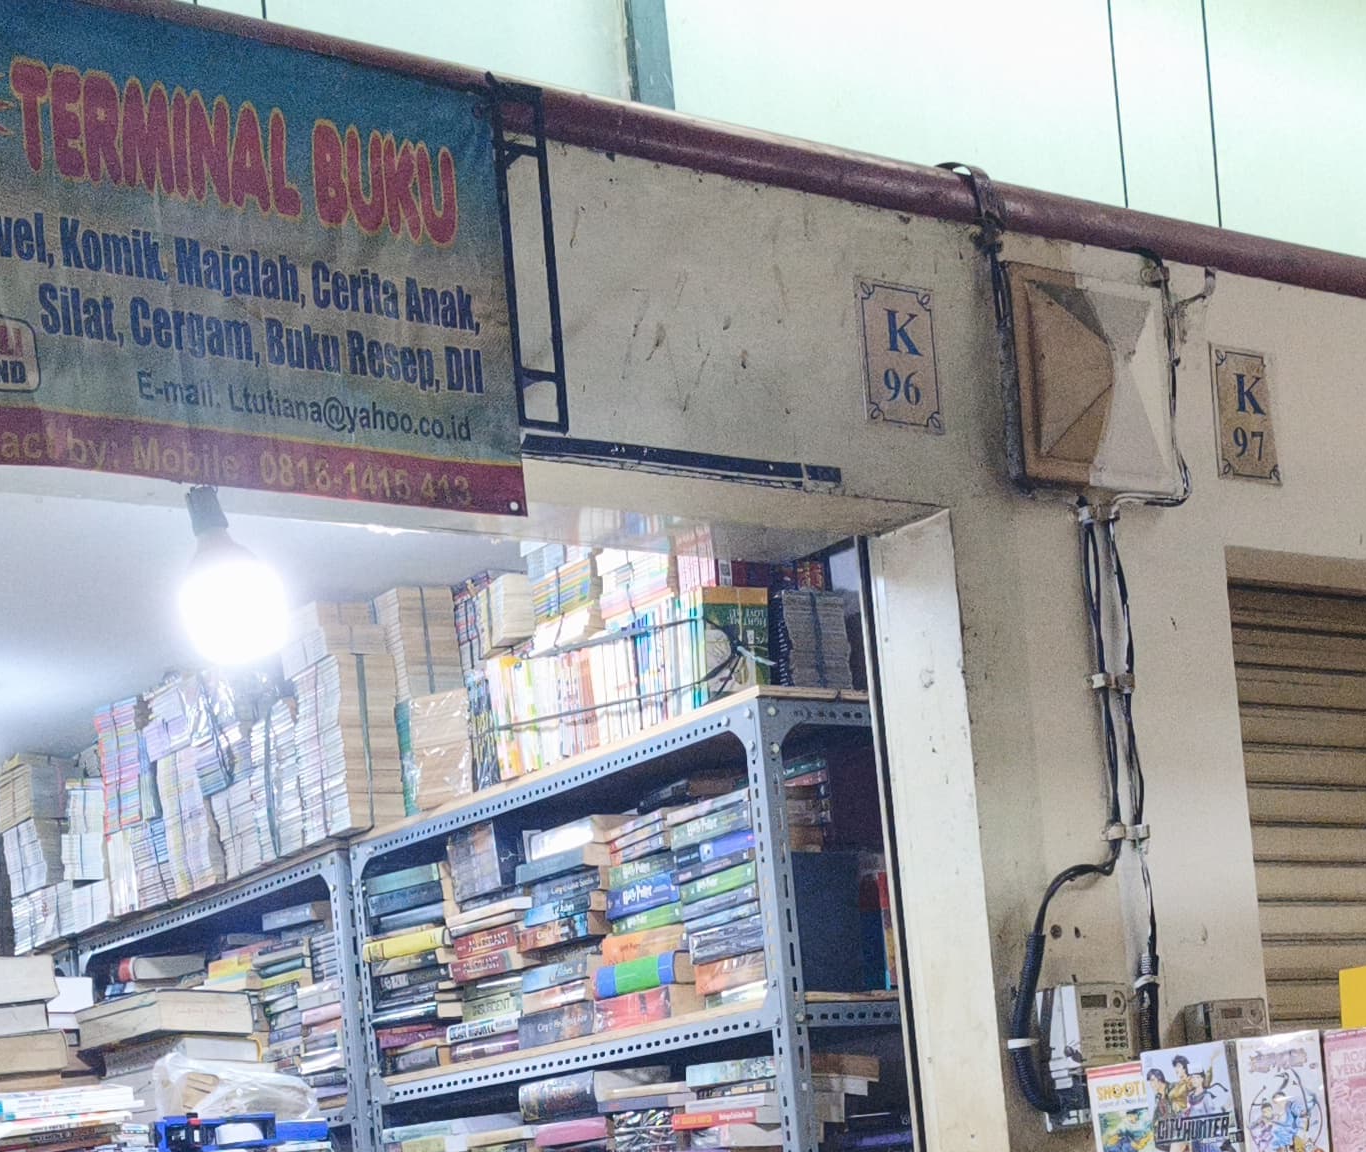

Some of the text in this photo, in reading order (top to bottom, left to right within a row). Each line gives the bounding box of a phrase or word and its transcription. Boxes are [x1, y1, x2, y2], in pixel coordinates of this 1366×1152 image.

[9, 57, 457, 246] TERMINAL BUKU
[60, 215, 169, 283] Komik,
[175, 239, 306, 308] Majalah,
[311, 261, 399, 317] Cerita
[405, 278, 481, 335] Anak,
[38, 283, 484, 395] Silat, Cergam, Buku Resep, Dll
[884, 308, 922, 358] K
[137, 370, 222, 408] E-mail:
[883, 368, 923, 406] 96
[1236, 373, 1267, 417] K
[132, 437, 240, 481] Mobile
[1232, 426, 1266, 463] 97
